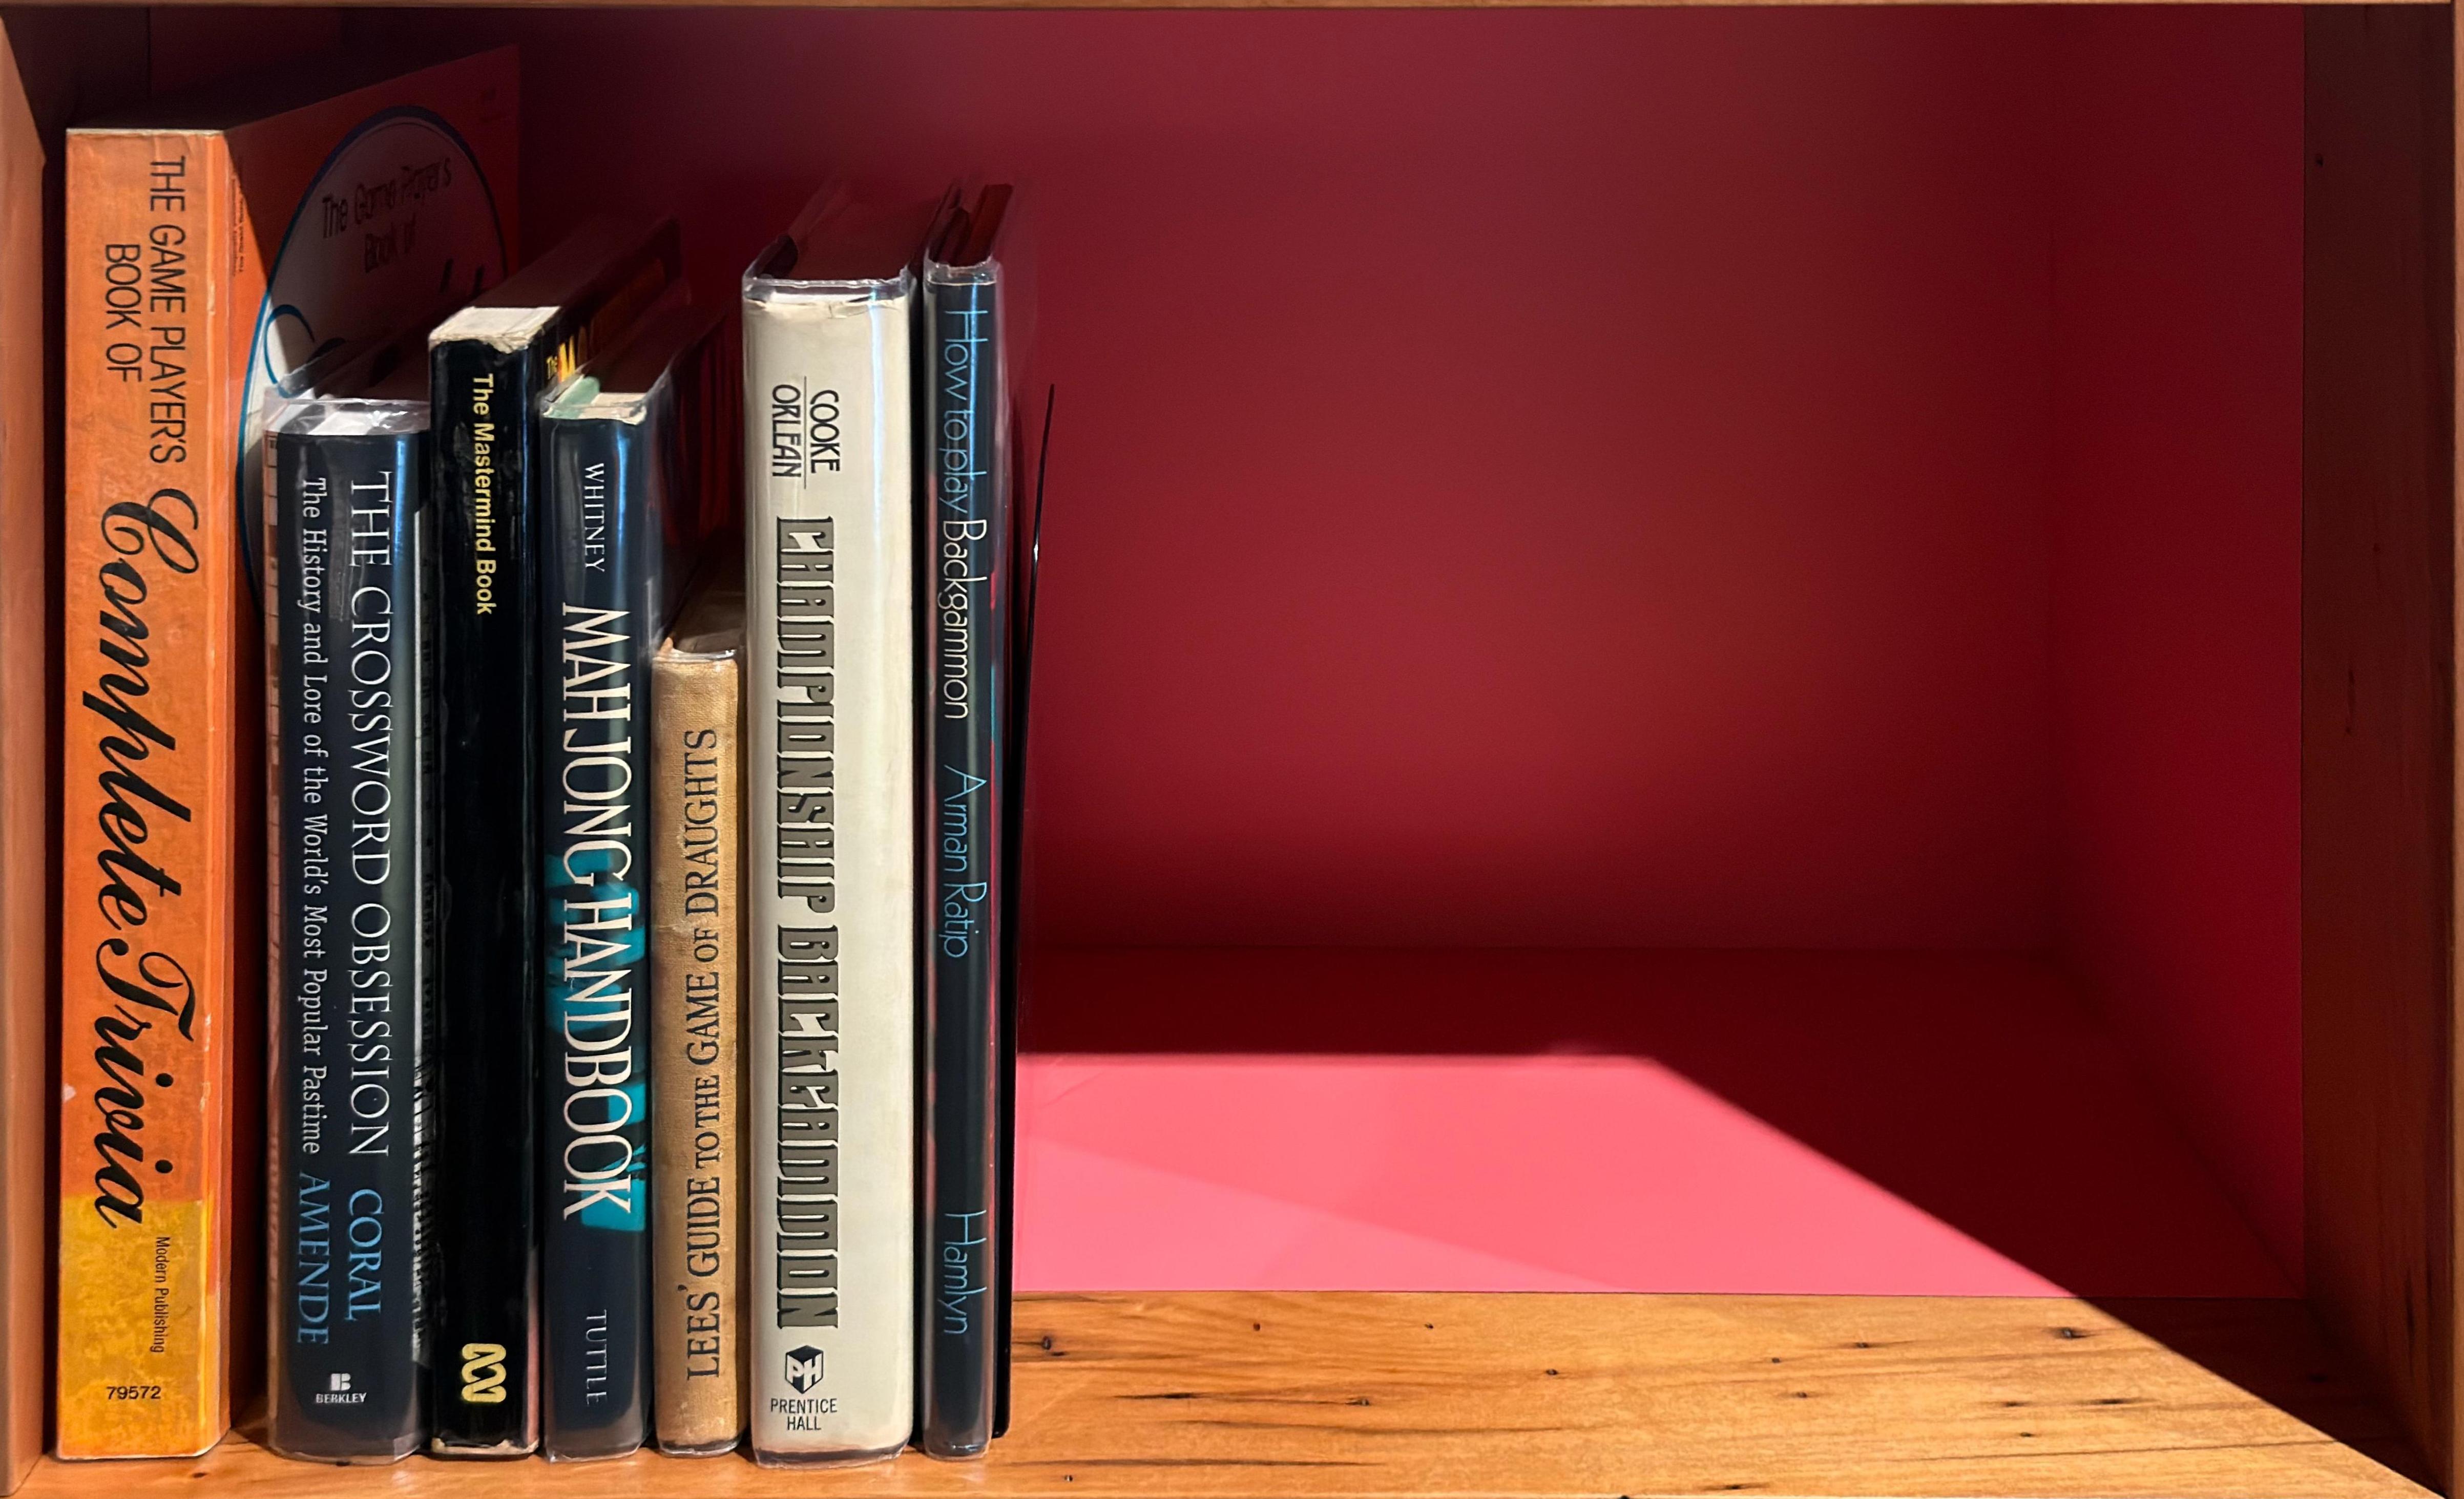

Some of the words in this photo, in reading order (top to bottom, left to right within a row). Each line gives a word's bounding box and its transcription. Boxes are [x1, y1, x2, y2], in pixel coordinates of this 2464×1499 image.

[151, 156, 185, 211] THE
[106, 244, 141, 329] BOOK
[150, 225, 185, 312] GAME
[106, 344, 142, 382] OF
[150, 327, 186, 463] PLAYER'S
[474, 374, 493, 415] The
[944, 310, 988, 401] How
[772, 385, 801, 477] ORLEAN
[810, 390, 840, 473] COOKE
[944, 408, 975, 442] to
[302, 478, 327, 517] The
[350, 472, 391, 566] THE
[475, 424, 495, 551] Mastermind
[584, 463, 604, 572] WHITNEY
[938, 447, 987, 514] play
[298, 529, 327, 613] History
[477, 560, 496, 614] Book
[304, 623, 328, 663] and
[938, 519, 988, 719] Backgammon
[83, 489, 199, 930] Complete
[304, 675, 327, 723] Lore
[349, 587, 393, 884] CROSSWORD
[777, 517, 833, 913] CHAMPIONSHIP
[304, 735, 328, 757] of
[304, 767, 328, 803] the
[304, 814, 328, 894] World's
[684, 730, 718, 916] DRAUGHTS
[943, 765, 987, 872] Arman
[304, 905, 327, 957] Most
[693, 928, 718, 962] OF
[939, 881, 987, 958] Ratip
[298, 969, 328, 1055] Popular
[349, 903, 392, 1155] OBSESSION
[686, 972, 720, 1065] GAME
[94, 939, 195, 1228] Trivia
[565, 893, 632, 1219] HANDBOOK
[303, 1066, 327, 1153] Pastime
[695, 1075, 719, 1128] THE
[777, 925, 838, 1329] BACKGAMMON
[695, 1132, 719, 1169] TO
[156, 1237, 170, 1282] Modern
[297, 1172, 331, 1344] AMENDE
[345, 1188, 385, 1320] CORAL
[687, 1177, 720, 1277] GUIDE
[938, 1209, 987, 1335] Hamlyn
[150, 1289, 169, 1352] Publishing
[586, 1310, 607, 1406] TUTTLE
[678, 1285, 719, 1380] LEES'
[107, 1386, 160, 1400] 79572
[317, 1393, 366, 1403] BERKLEY
[771, 1398, 837, 1413] PRENTICE
[787, 1417, 822, 1431] HALL
